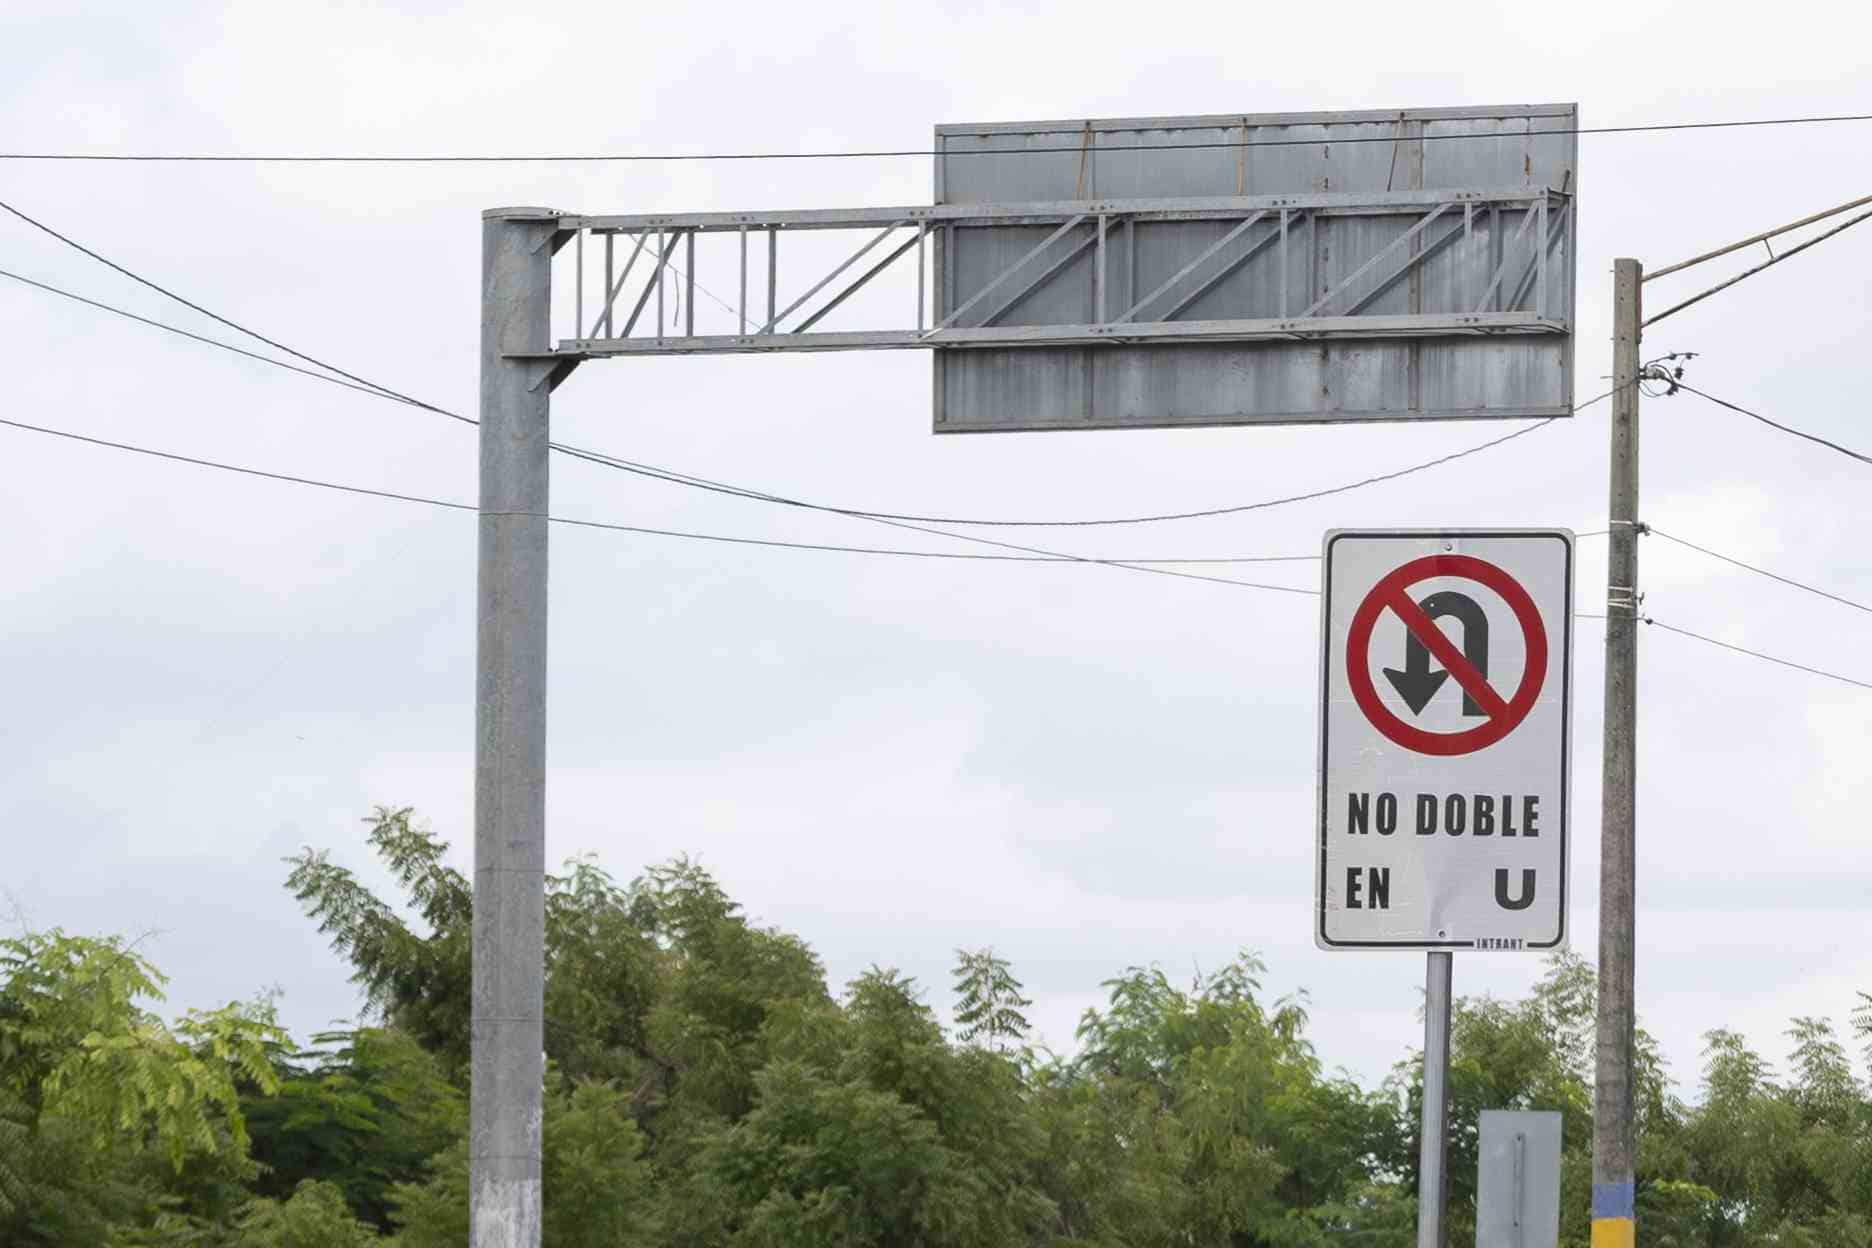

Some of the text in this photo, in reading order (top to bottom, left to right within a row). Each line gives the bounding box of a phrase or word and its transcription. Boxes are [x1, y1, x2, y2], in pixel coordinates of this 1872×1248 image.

[1347, 792, 1540, 838] NO DOBLE
[1346, 867, 1537, 911] EN U
[1476, 937, 1524, 950] INTRANT
